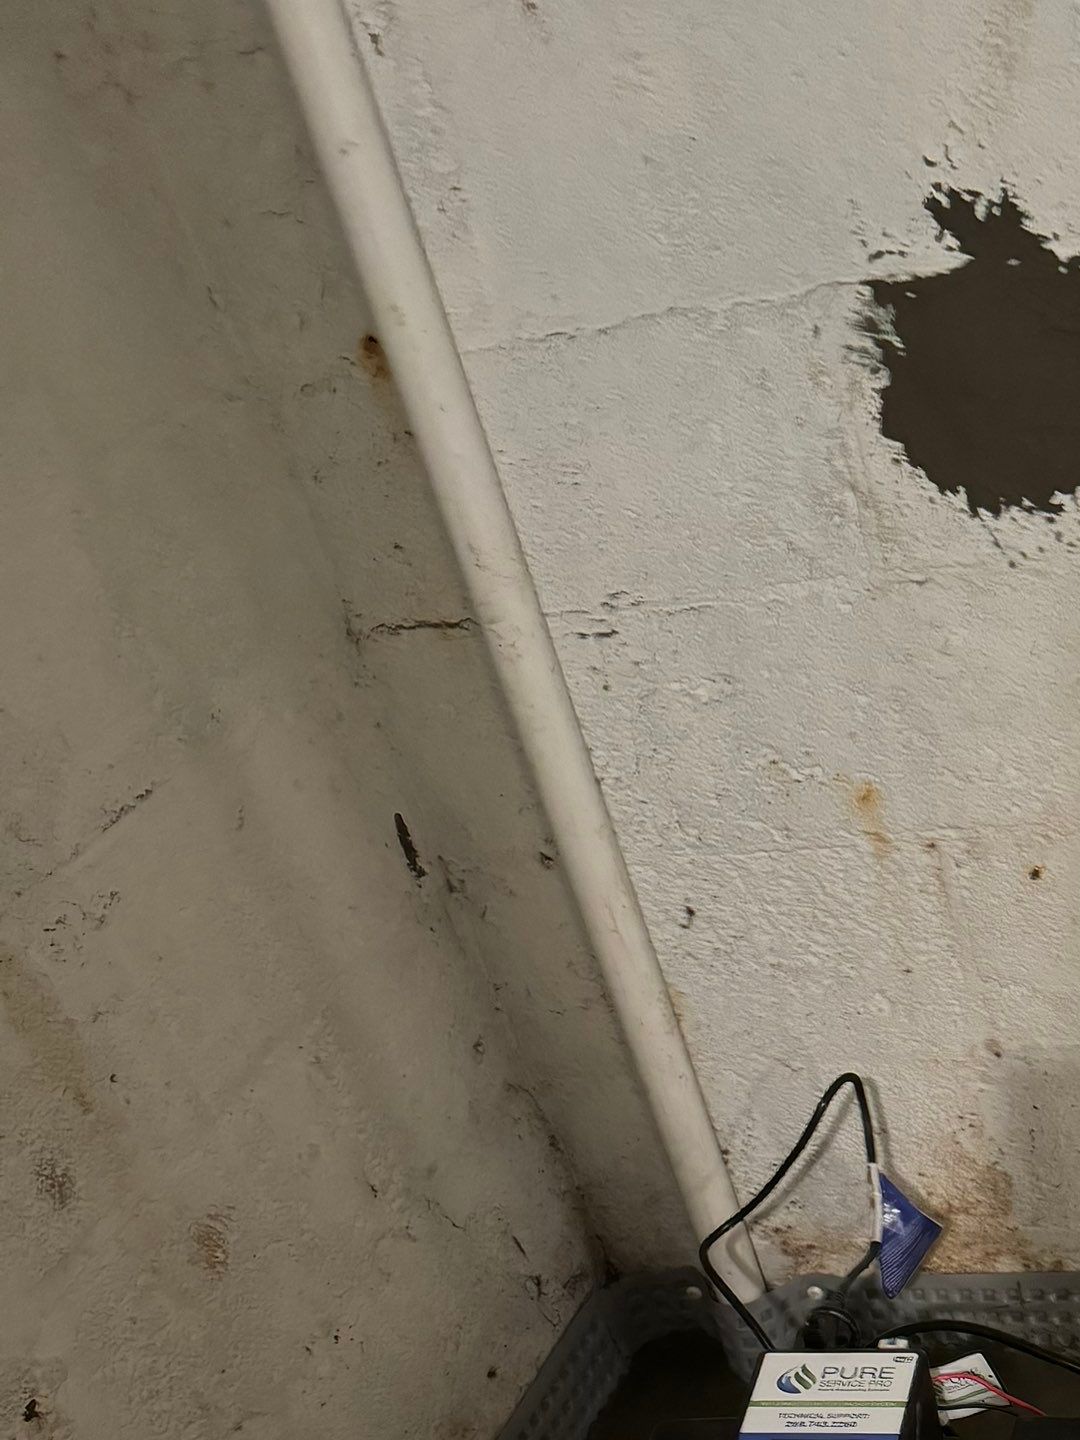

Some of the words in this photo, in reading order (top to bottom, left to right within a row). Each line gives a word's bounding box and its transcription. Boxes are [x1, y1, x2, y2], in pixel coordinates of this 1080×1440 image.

[822, 1366, 896, 1380] PURE
[819, 1380, 866, 1388] SERVICE
[868, 1380, 892, 1388] PRO
